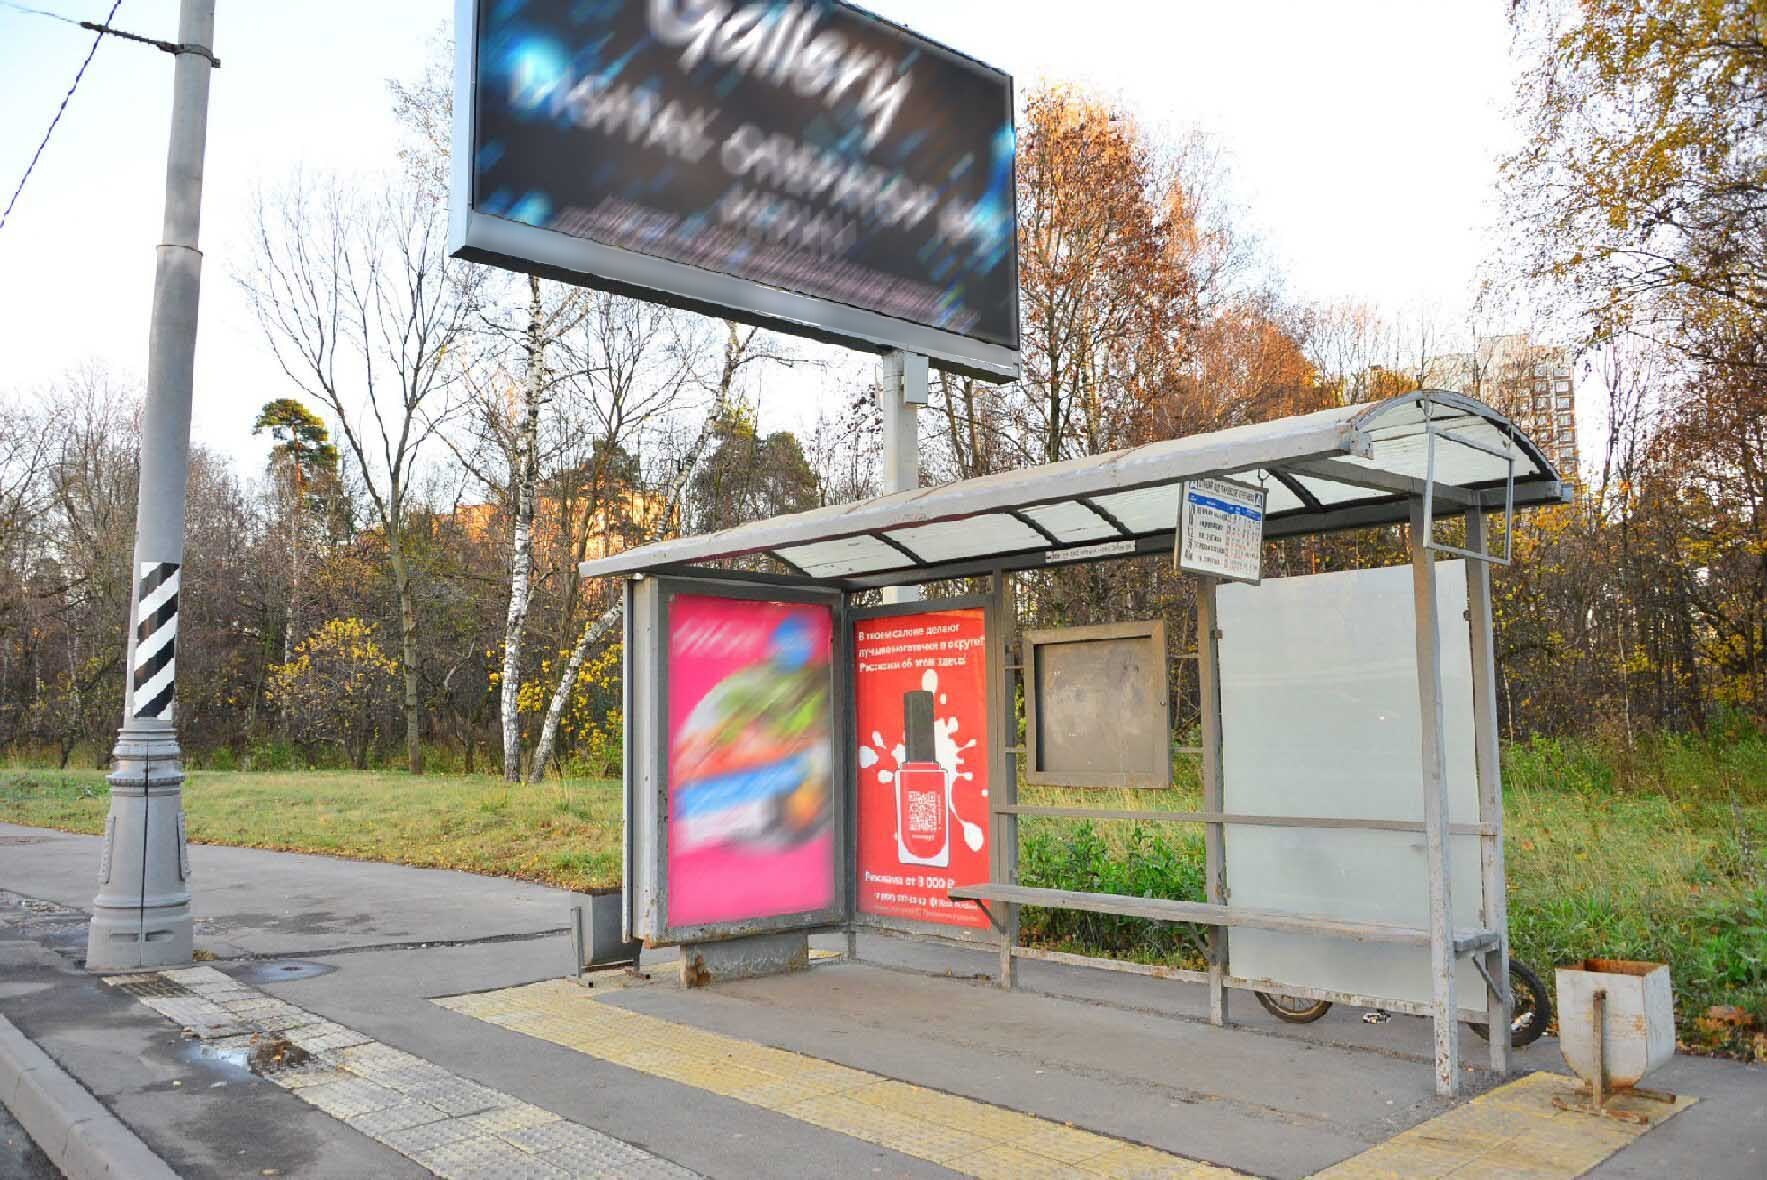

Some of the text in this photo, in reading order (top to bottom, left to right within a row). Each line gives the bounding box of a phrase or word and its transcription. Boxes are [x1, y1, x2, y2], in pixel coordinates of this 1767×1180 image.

[859, 632, 865, 641] В
[926, 623, 960, 635] делают
[902, 659, 912, 668] об
[905, 876, 917, 886] от
